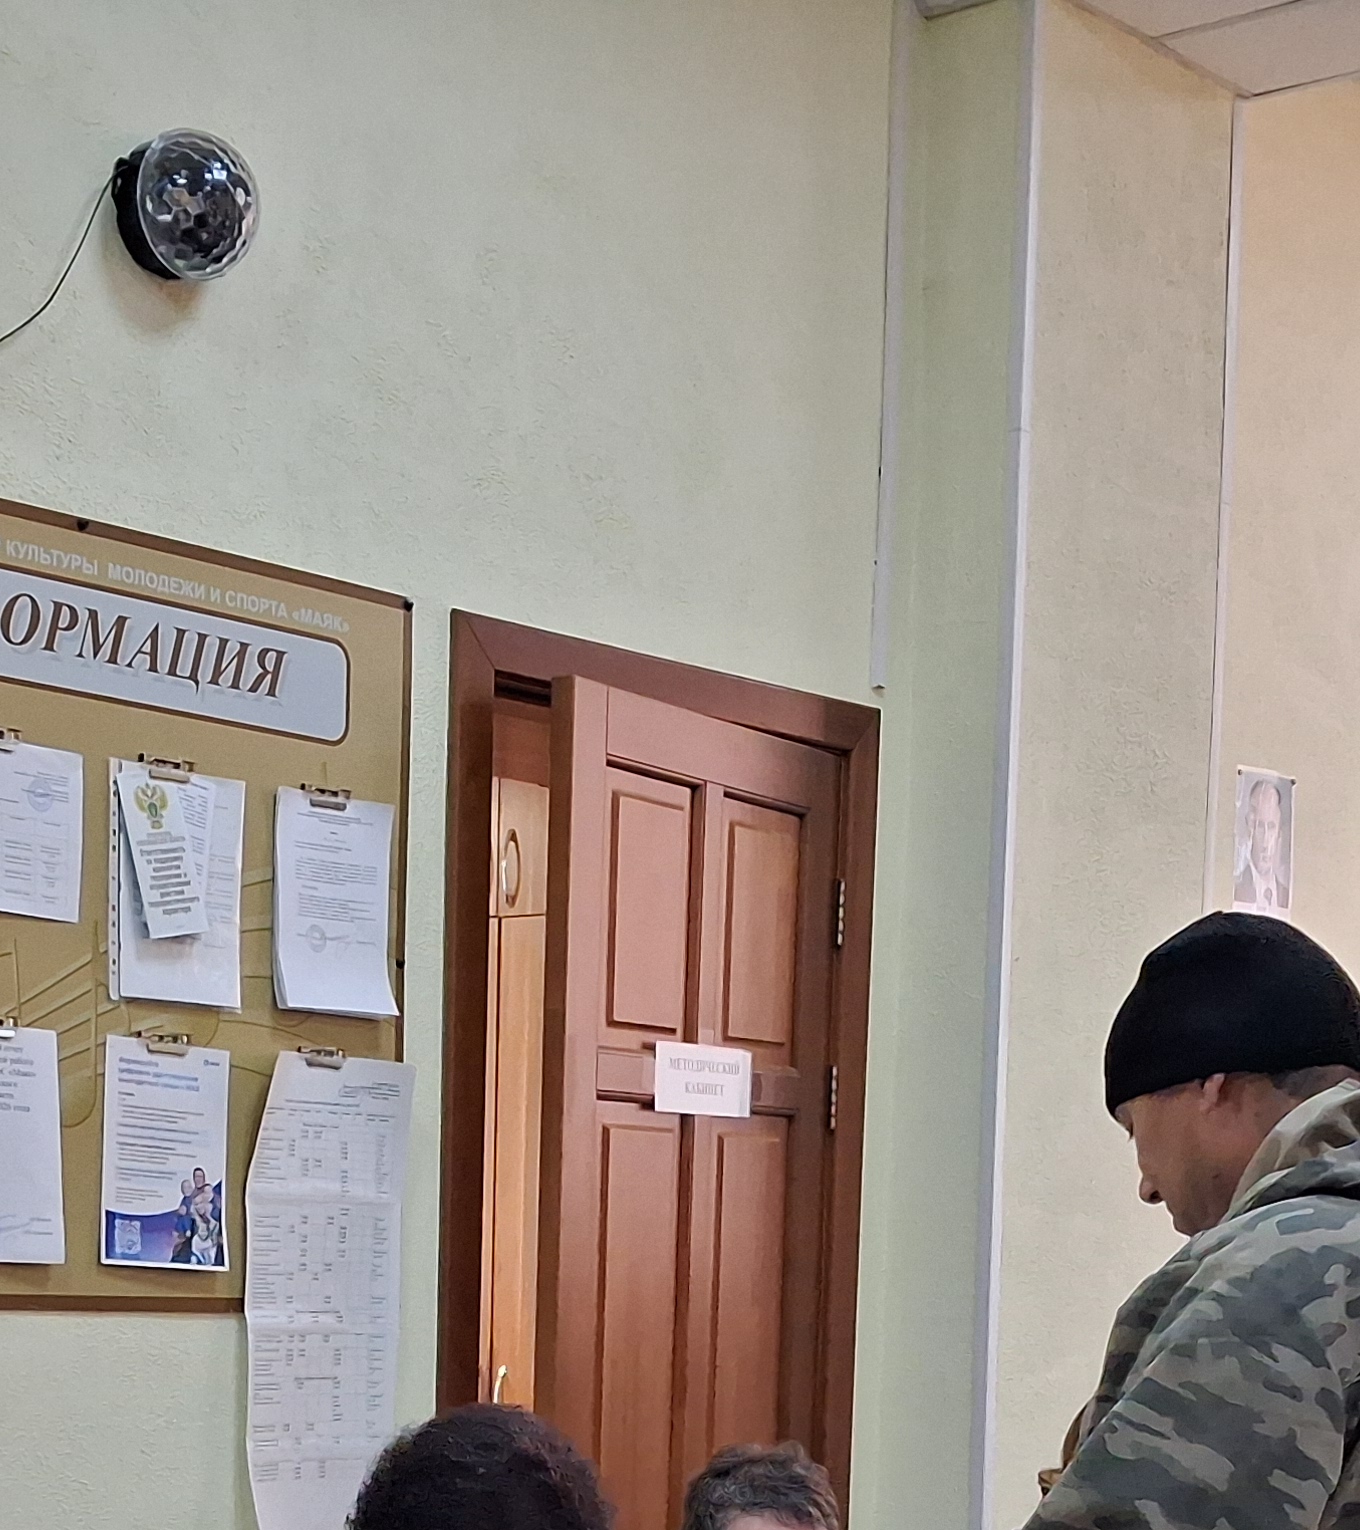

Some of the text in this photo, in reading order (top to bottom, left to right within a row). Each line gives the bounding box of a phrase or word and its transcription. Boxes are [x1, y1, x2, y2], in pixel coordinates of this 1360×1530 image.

[6, 541, 98, 576] КУЛЬТУРЫ
[108, 562, 206, 601] МОЛОДЕЖИ
[210, 585, 223, 603] И
[225, 590, 288, 618] СПОРТА
[292, 608, 351, 633] «МАЯК»
[685, 1082, 724, 1097] КАБИНЕТ
